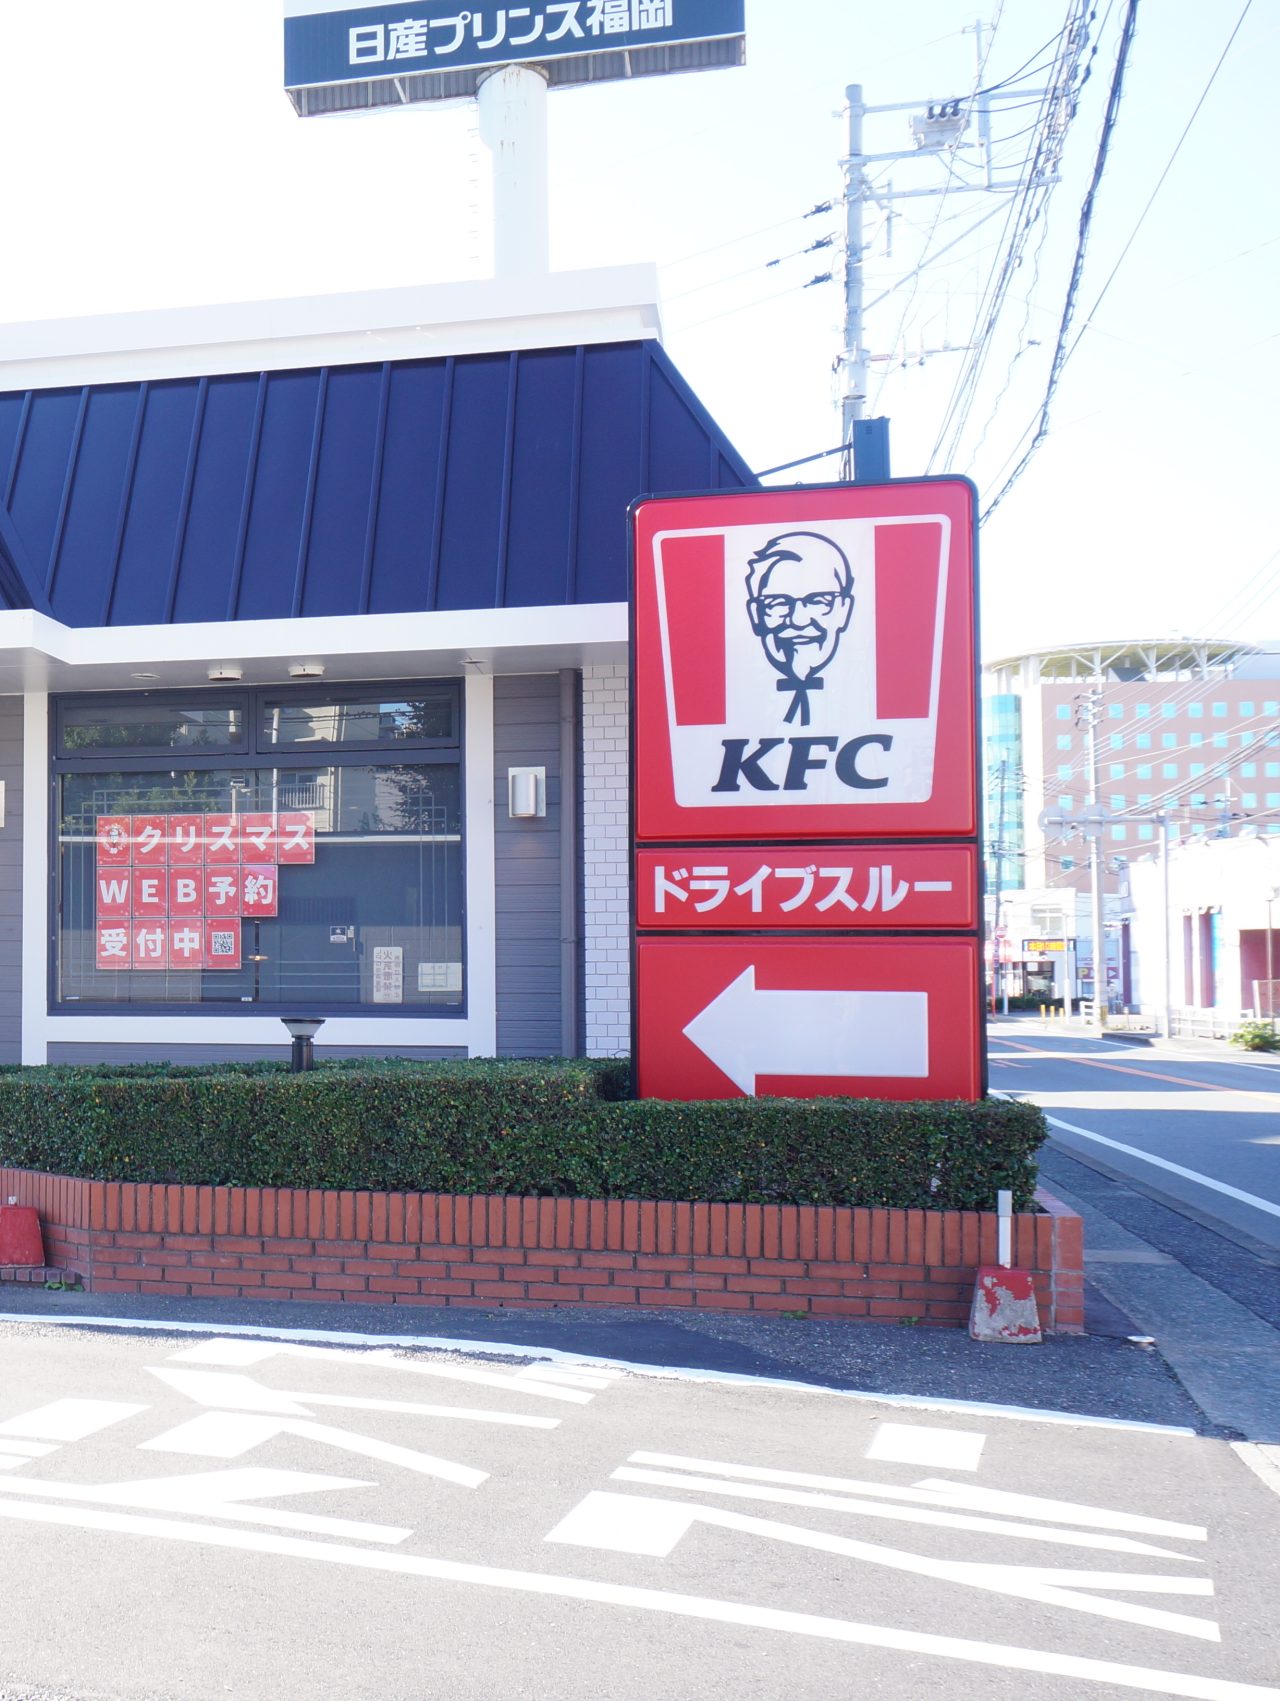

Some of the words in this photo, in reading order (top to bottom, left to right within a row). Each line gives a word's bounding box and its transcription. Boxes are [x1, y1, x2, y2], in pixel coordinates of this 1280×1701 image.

[349, 0, 673, 65] 日産プリンス福岡
[711, 734, 893, 793] KFC
[137, 824, 310, 854] クリスマス
[99, 874, 274, 906] WEB予約
[655, 865, 952, 914] ドライブスルー
[100, 927, 201, 957] 受付中
